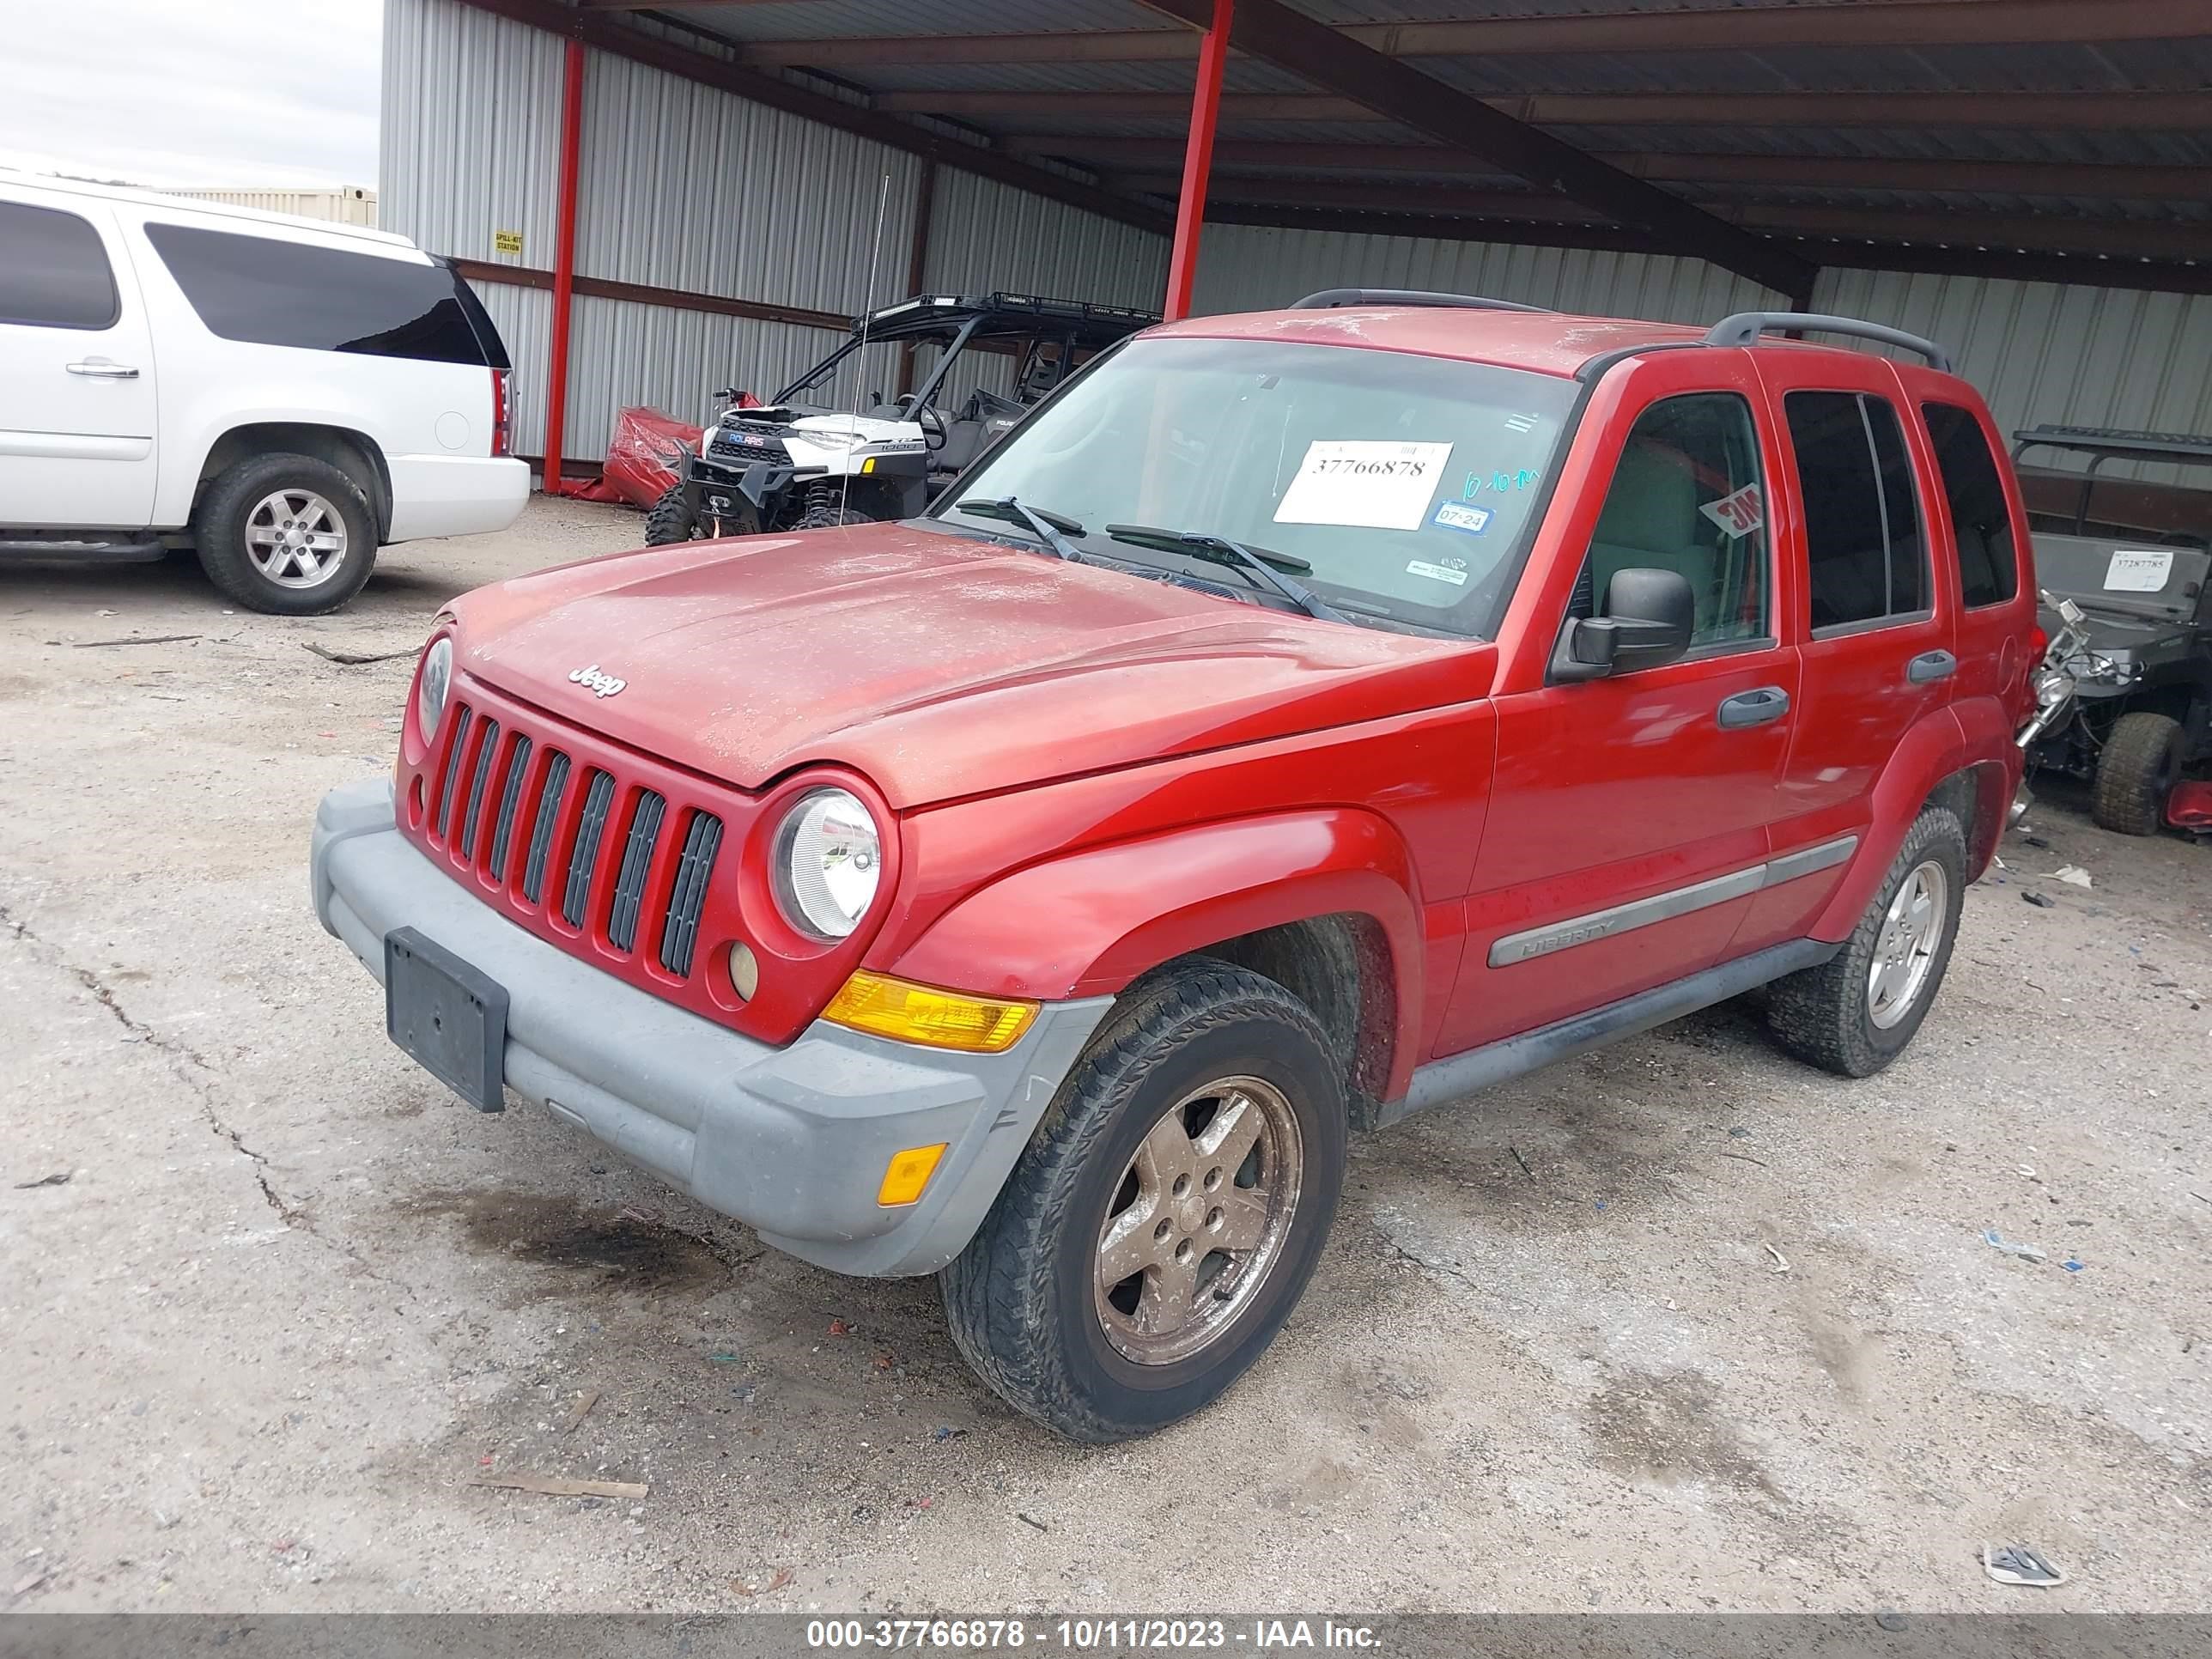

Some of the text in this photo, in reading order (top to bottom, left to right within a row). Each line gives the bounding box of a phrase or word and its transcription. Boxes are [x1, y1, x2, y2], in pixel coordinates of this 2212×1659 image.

[497, 242, 520, 251] STATION
[730, 433, 764, 447] POLARIS
[1312, 459, 1426, 477] 37766878
[568, 664, 628, 699] Jeep
[1522, 921, 1615, 956] LIBERTY
